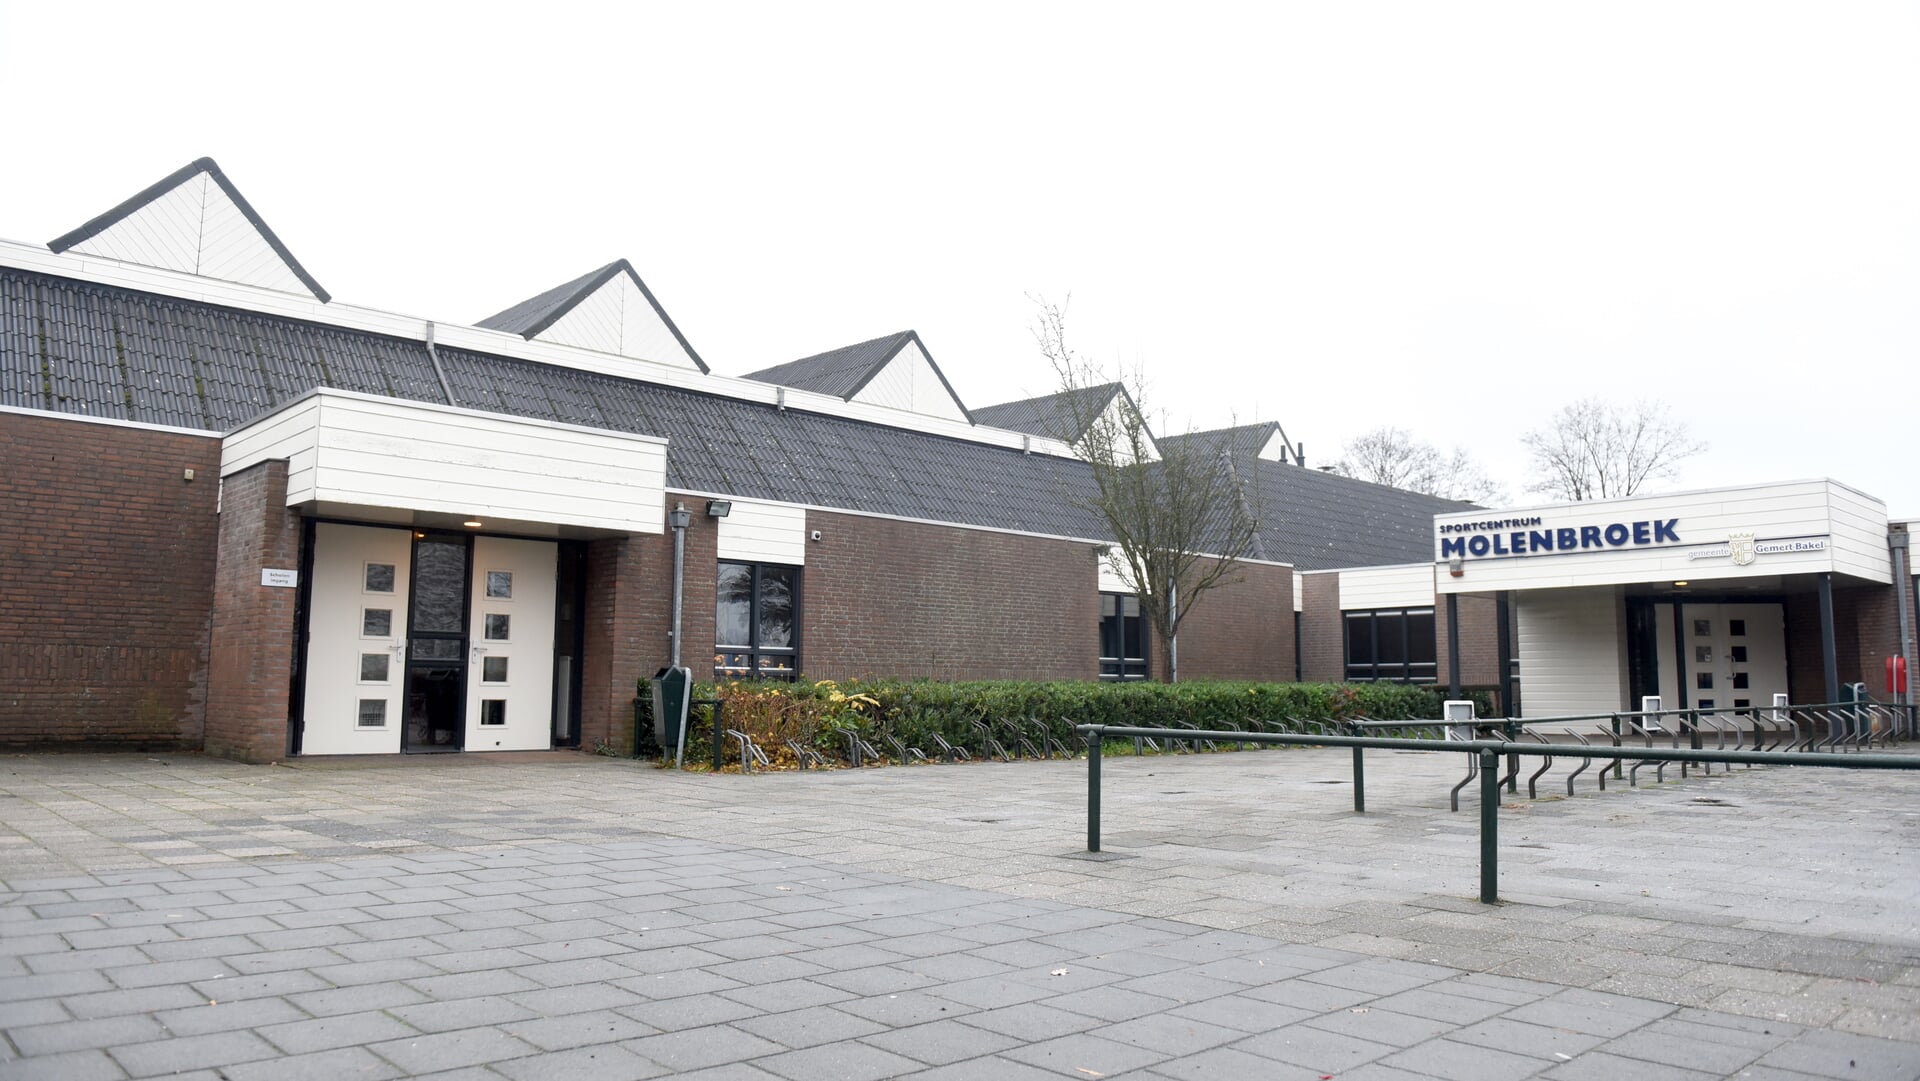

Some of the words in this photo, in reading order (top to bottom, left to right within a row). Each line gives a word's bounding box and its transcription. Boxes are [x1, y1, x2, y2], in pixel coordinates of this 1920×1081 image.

[1440, 517, 1541, 533] SPORTCENTRUM
[1441, 519, 1680, 558] MOLENBROEK
[1688, 549, 1729, 560] gemeente
